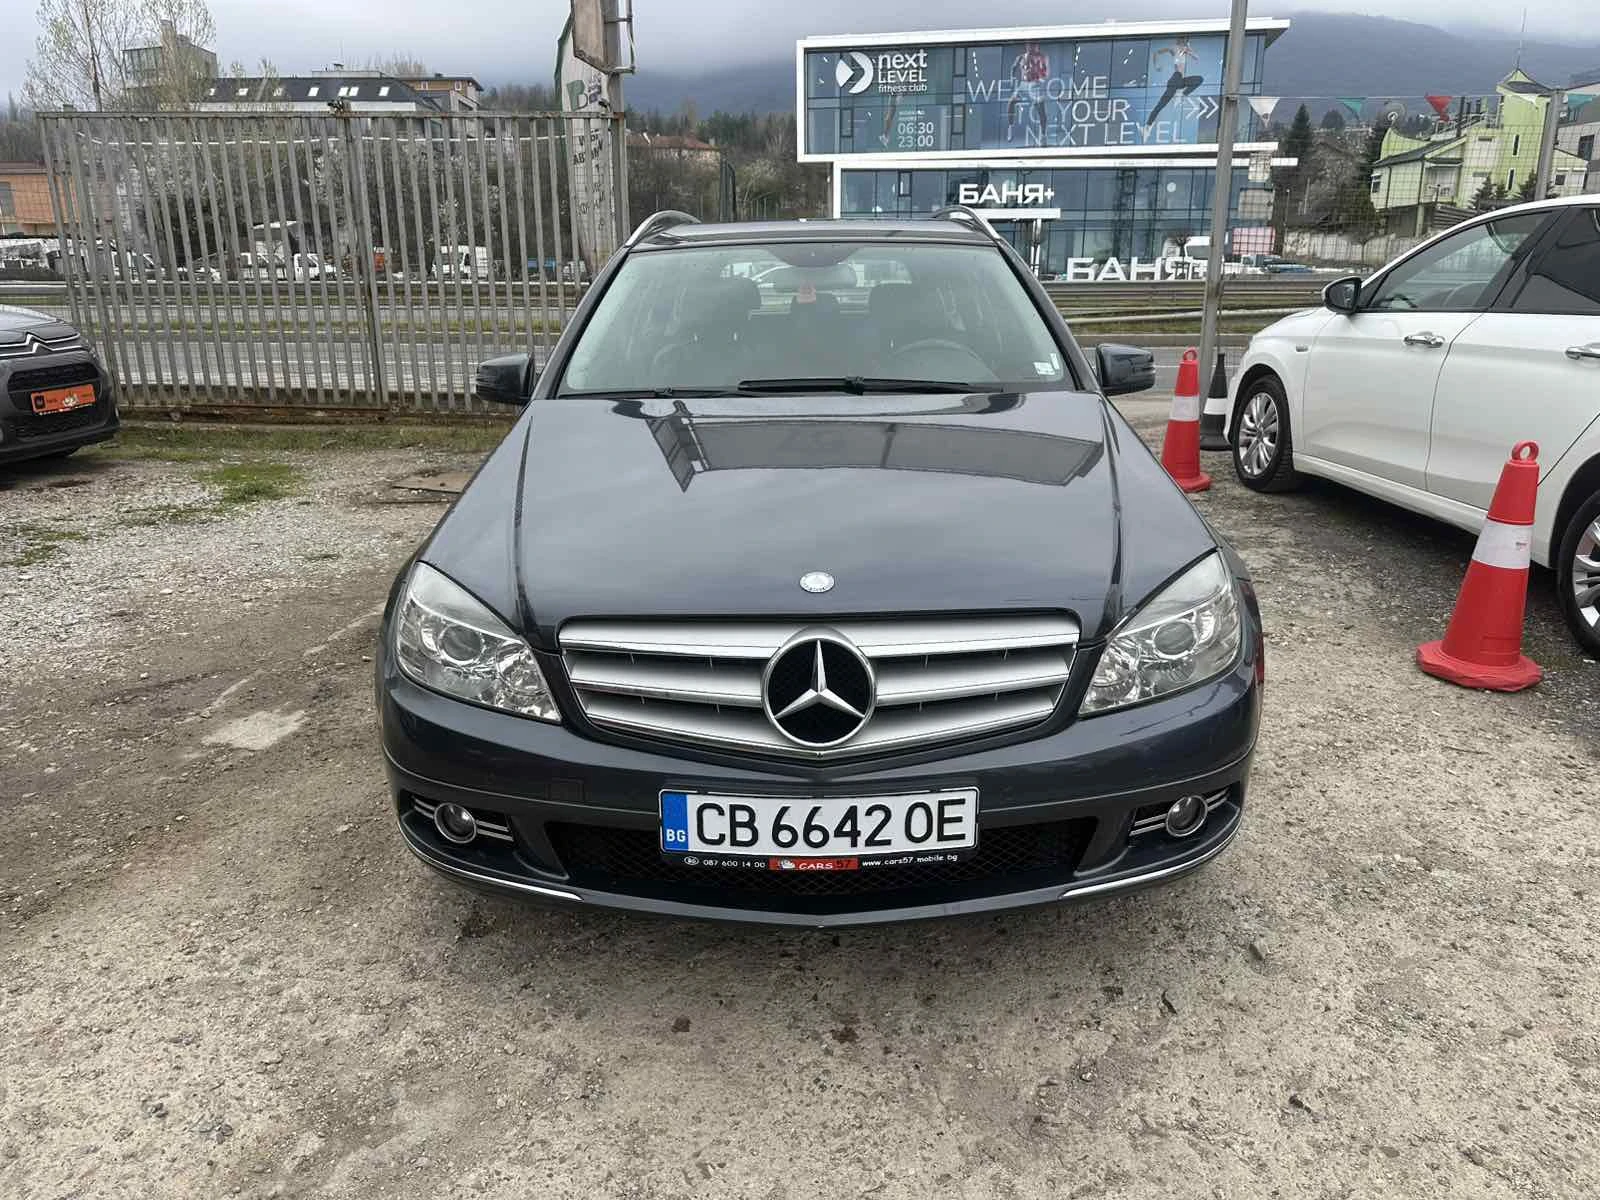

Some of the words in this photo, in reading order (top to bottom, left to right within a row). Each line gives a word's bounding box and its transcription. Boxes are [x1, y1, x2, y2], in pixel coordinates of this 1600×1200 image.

[878, 49, 928, 69] next
[878, 69, 928, 83] LEVEL
[878, 84, 907, 94] fitness
[908, 83, 928, 93] club
[967, 76, 1107, 103] WELCOME
[1055, 98, 1130, 122] YOUR
[898, 121, 935, 134] 06:30
[1025, 123, 1096, 147] NEXT
[1104, 121, 1188, 145] LEVEL
[898, 134, 935, 148] 23:00
[696, 802, 759, 847] CB
[771, 804, 892, 848] 6642
[904, 798, 966, 843] OE
[666, 829, 687, 843] BG
[702, 859, 719, 867] 087
[721, 860, 738, 868] 600
[753, 861, 766, 869] 00
[798, 862, 833, 871] CARS
